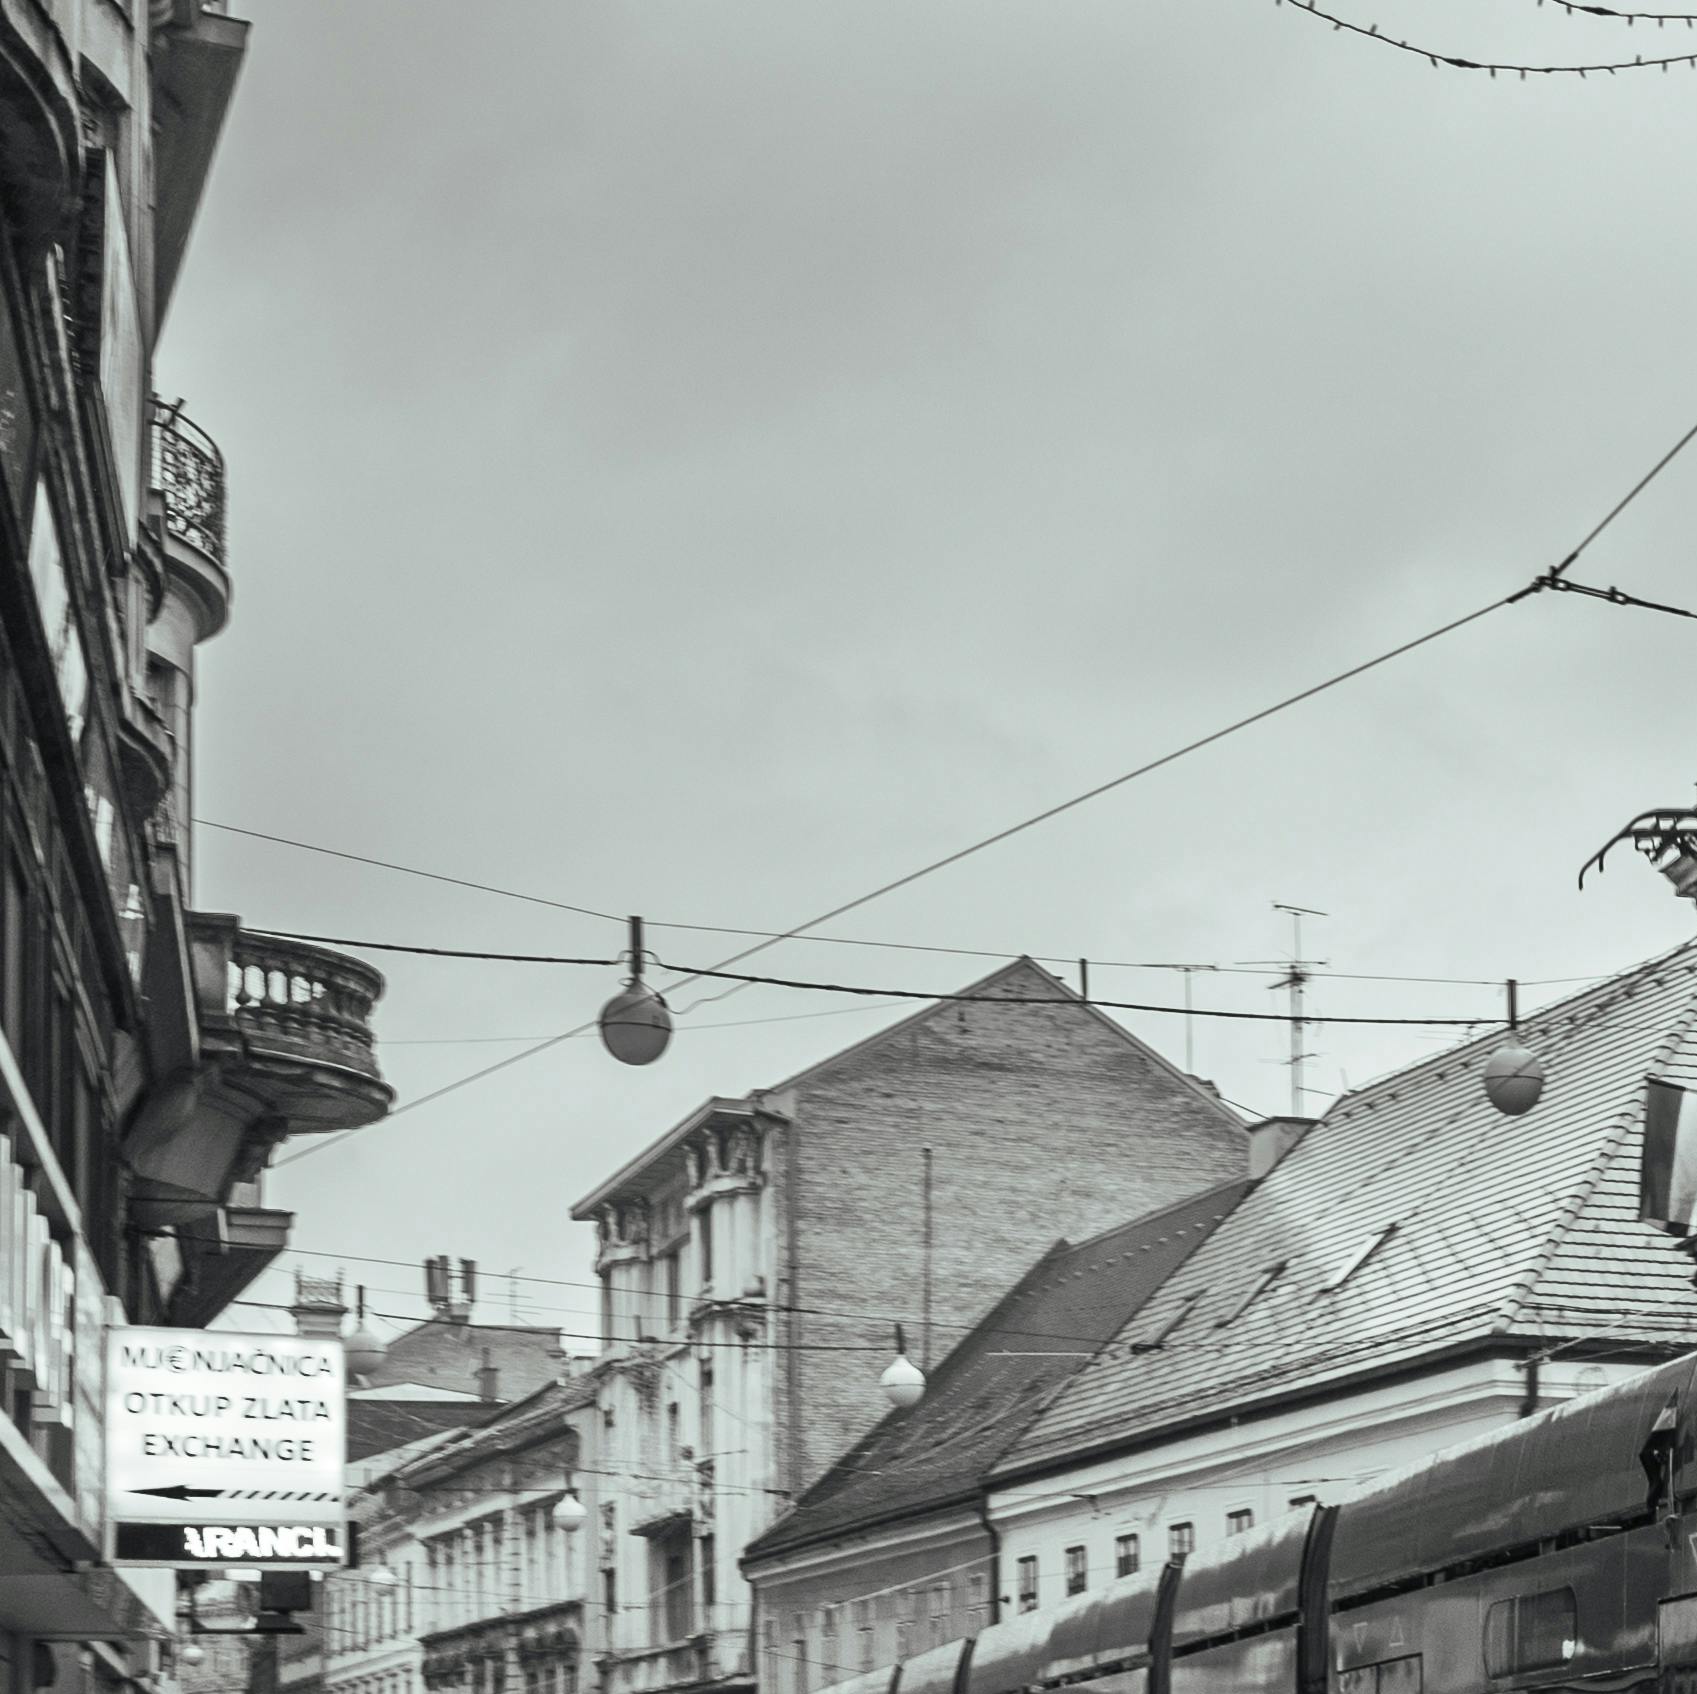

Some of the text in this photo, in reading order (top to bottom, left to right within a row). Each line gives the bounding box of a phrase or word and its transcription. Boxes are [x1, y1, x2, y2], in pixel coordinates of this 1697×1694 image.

[124, 1391, 331, 1420] OTKUP ZLATA
[143, 1434, 314, 1462] EXCHANGE
